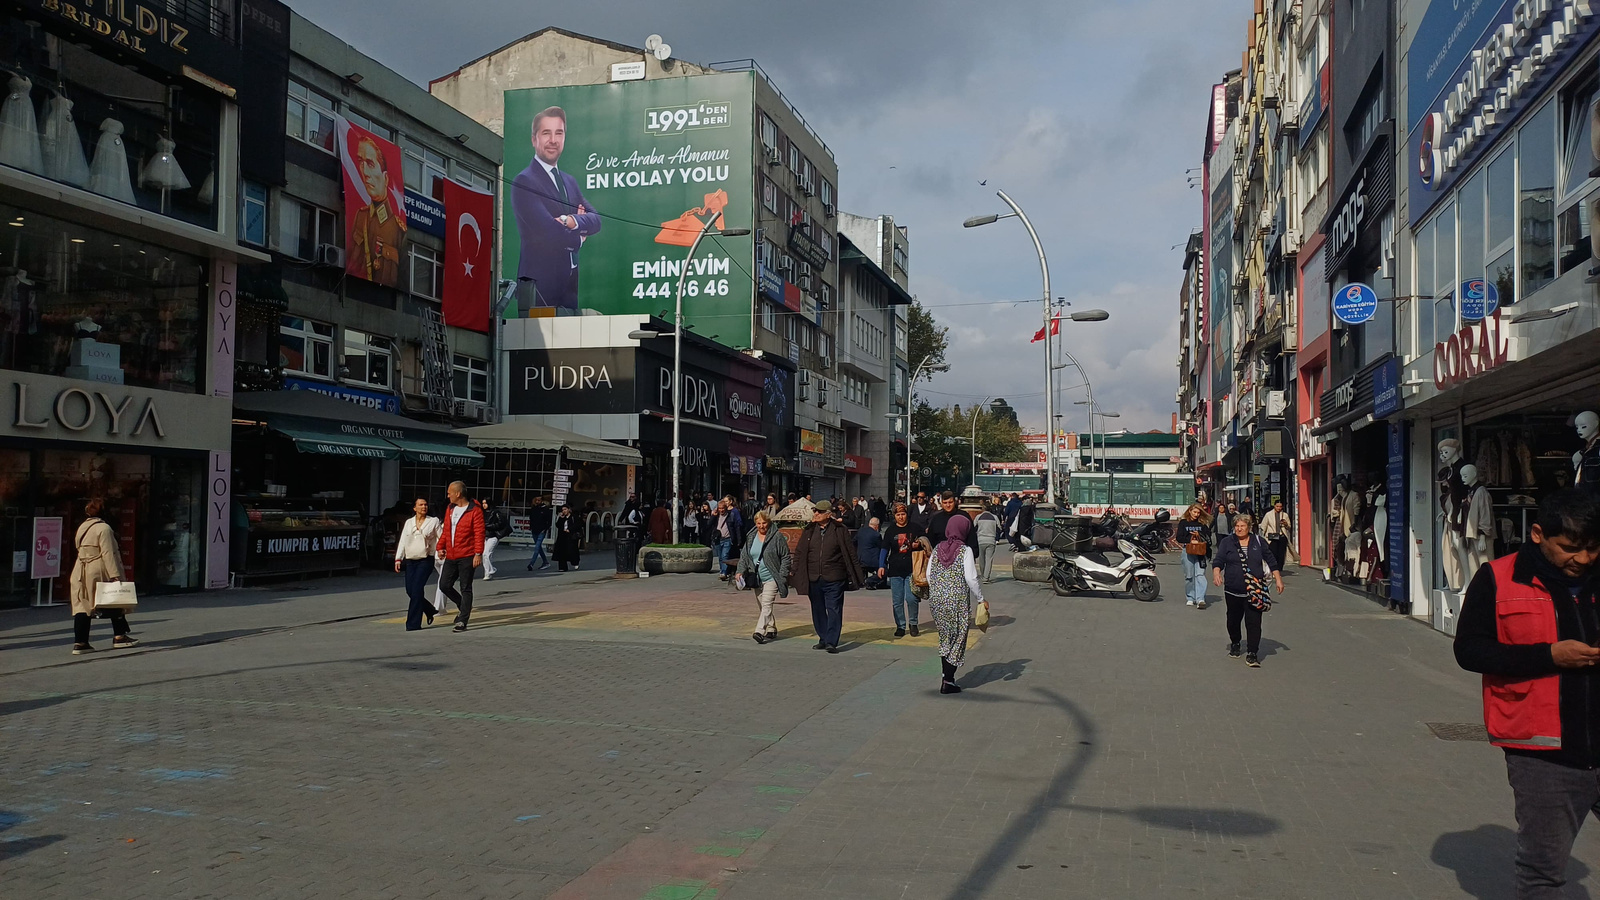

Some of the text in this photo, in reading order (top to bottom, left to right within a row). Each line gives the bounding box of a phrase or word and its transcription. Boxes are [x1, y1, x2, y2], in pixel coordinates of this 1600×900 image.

[42, 0, 147, 53] BRIDAL
[703, 113, 728, 126] BERİ
[586, 145, 730, 170] Ev ve Araba Almanın
[586, 165, 729, 189] EN KOLAY YOLU
[632, 253, 730, 279] EMİNEVİM
[632, 282, 671, 299] 444
[704, 279, 729, 296] 46
[220, 266, 233, 355] LOYA
[88, 350, 111, 359] LOYA
[1433, 308, 1509, 391] CORAL
[96, 374, 117, 382] LOYA
[524, 364, 613, 391] PUDRA
[659, 366, 720, 420] PUDRA
[13, 382, 166, 438] LOYA
[729, 393, 762, 419] KOMPEDAN
[341, 424, 404, 439] ORGANIC COFFEE
[317, 444, 387, 458] ORGANIC COFFEE
[419, 453, 472, 466] ORGANIC COFFEE
[679, 445, 709, 468] PUDRA
[213, 454, 227, 543] LOYA
[1079, 506, 1103, 515] BAKIRKÖY
[312, 537, 320, 552] &
[322, 535, 356, 550] WAFFLE
